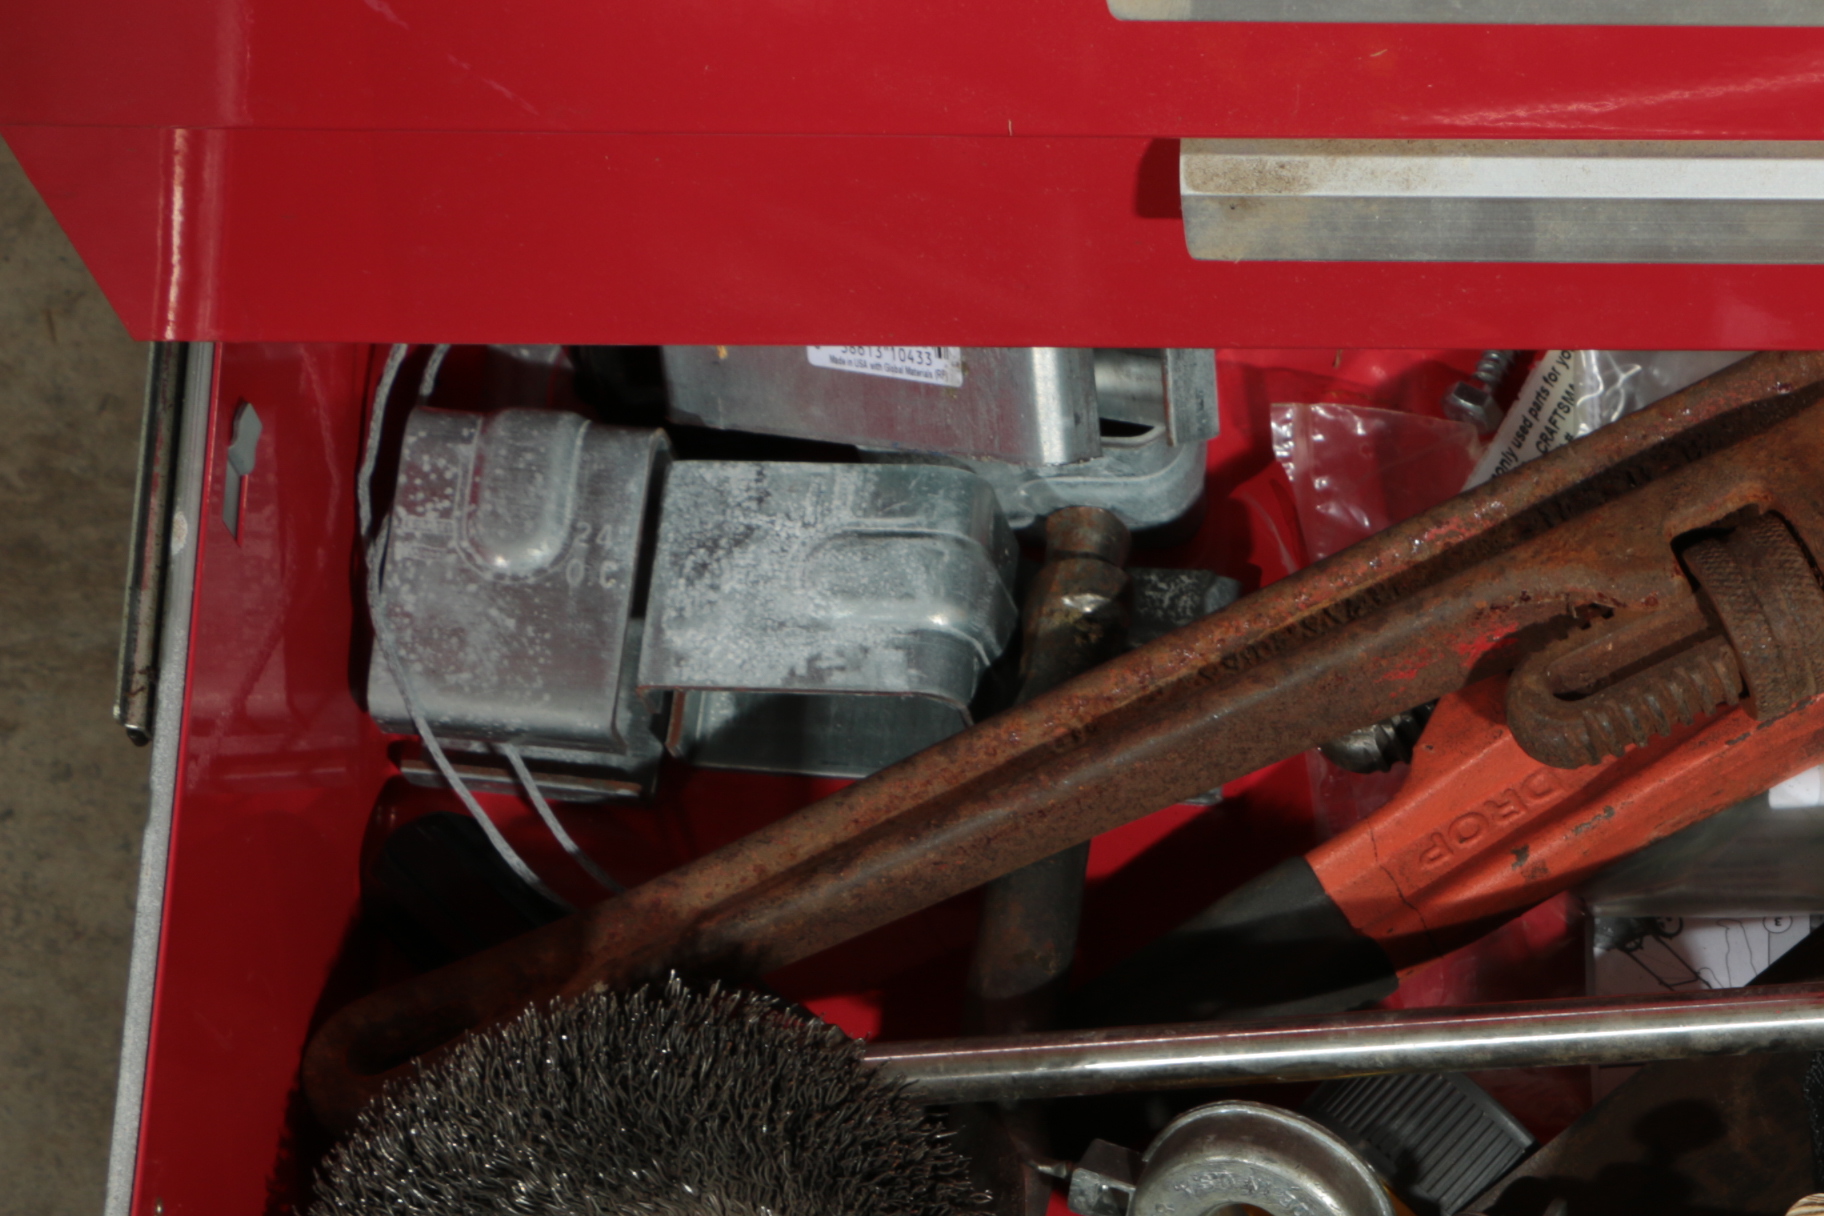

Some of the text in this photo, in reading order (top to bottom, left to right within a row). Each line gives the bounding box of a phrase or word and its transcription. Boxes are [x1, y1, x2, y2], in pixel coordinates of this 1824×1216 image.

[1511, 415, 1533, 449] used
[1528, 387, 1550, 421] parts
[1542, 366, 1561, 388] for
[1557, 350, 1575, 370] yo
[1419, 767, 1567, 864] DROP
